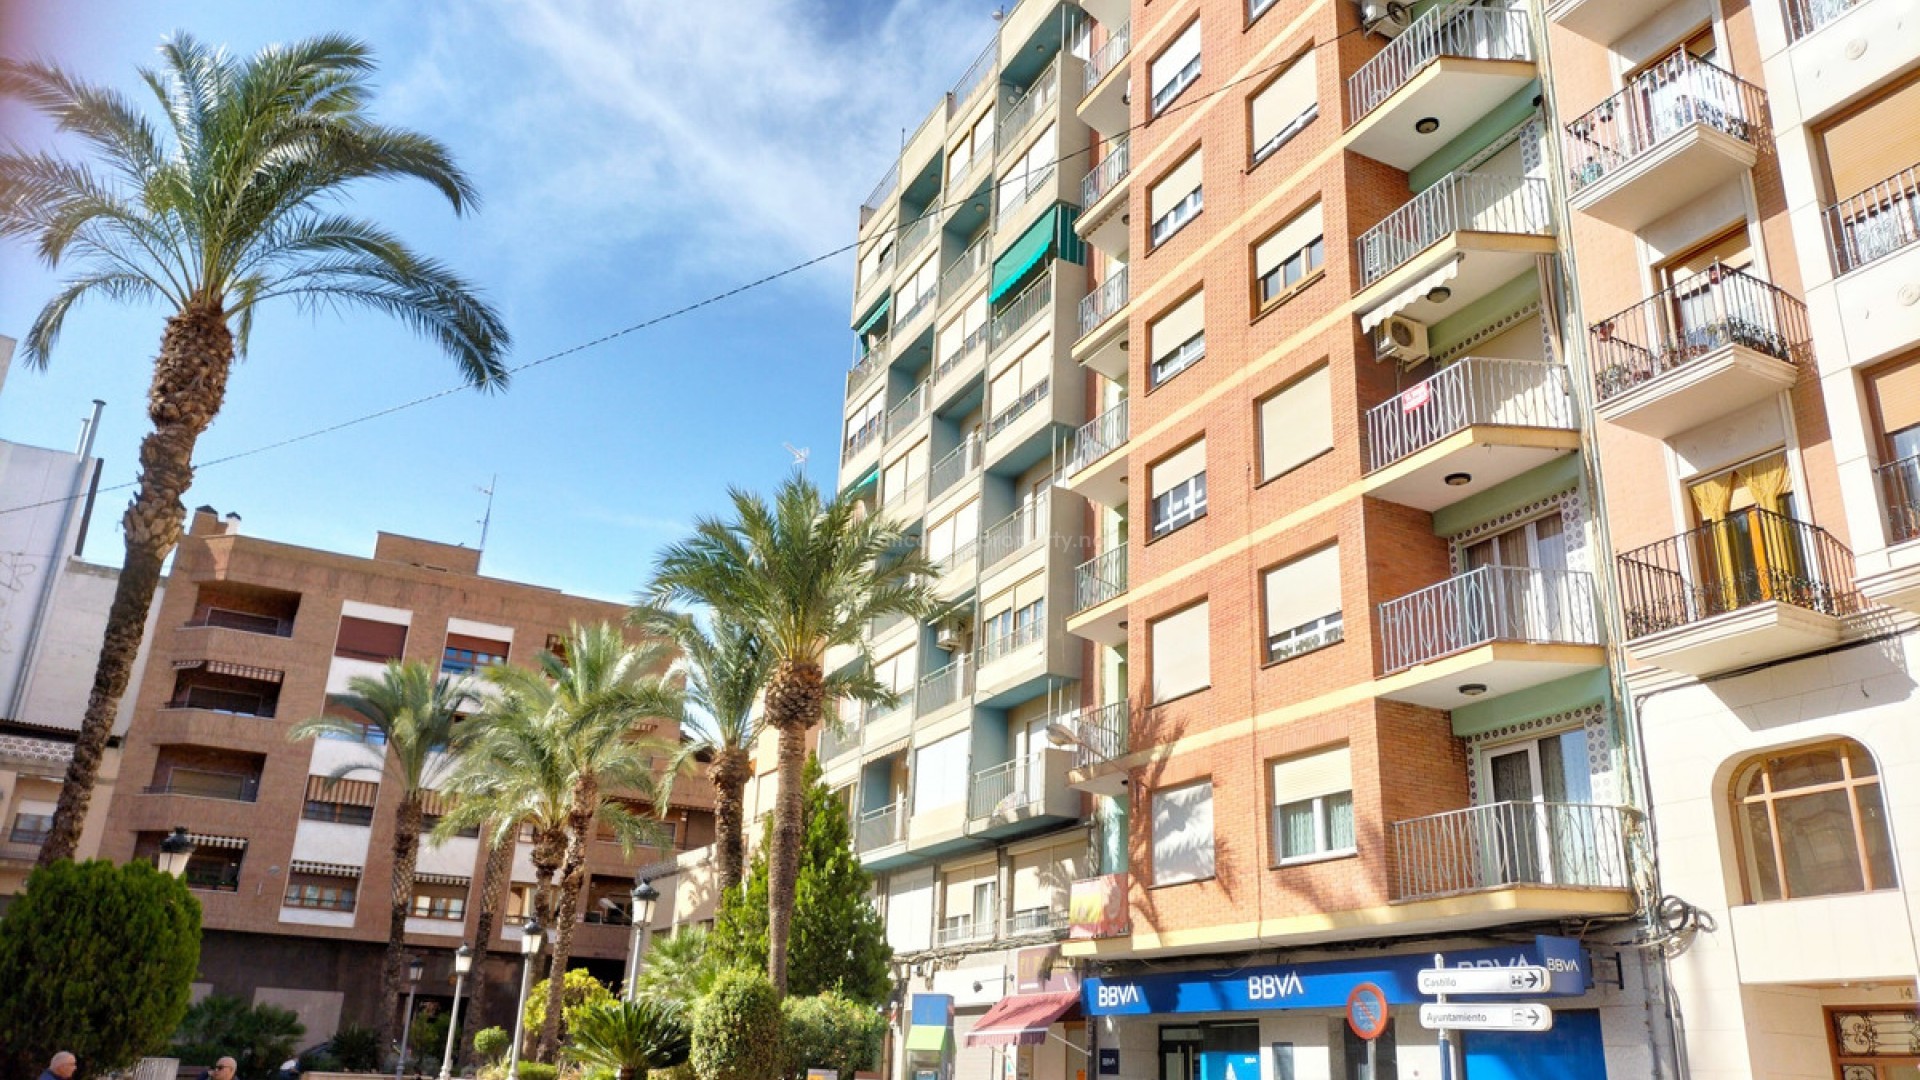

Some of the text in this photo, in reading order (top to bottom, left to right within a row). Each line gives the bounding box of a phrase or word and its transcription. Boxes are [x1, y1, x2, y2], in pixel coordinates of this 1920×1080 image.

[1547, 958, 1579, 972] BBVA
[1247, 971, 1303, 1000] BBVA
[1423, 977, 1457, 987] Castillo
[1099, 983, 1139, 1006] BBVA
[1426, 1012, 1487, 1023] Ayuntamiento
